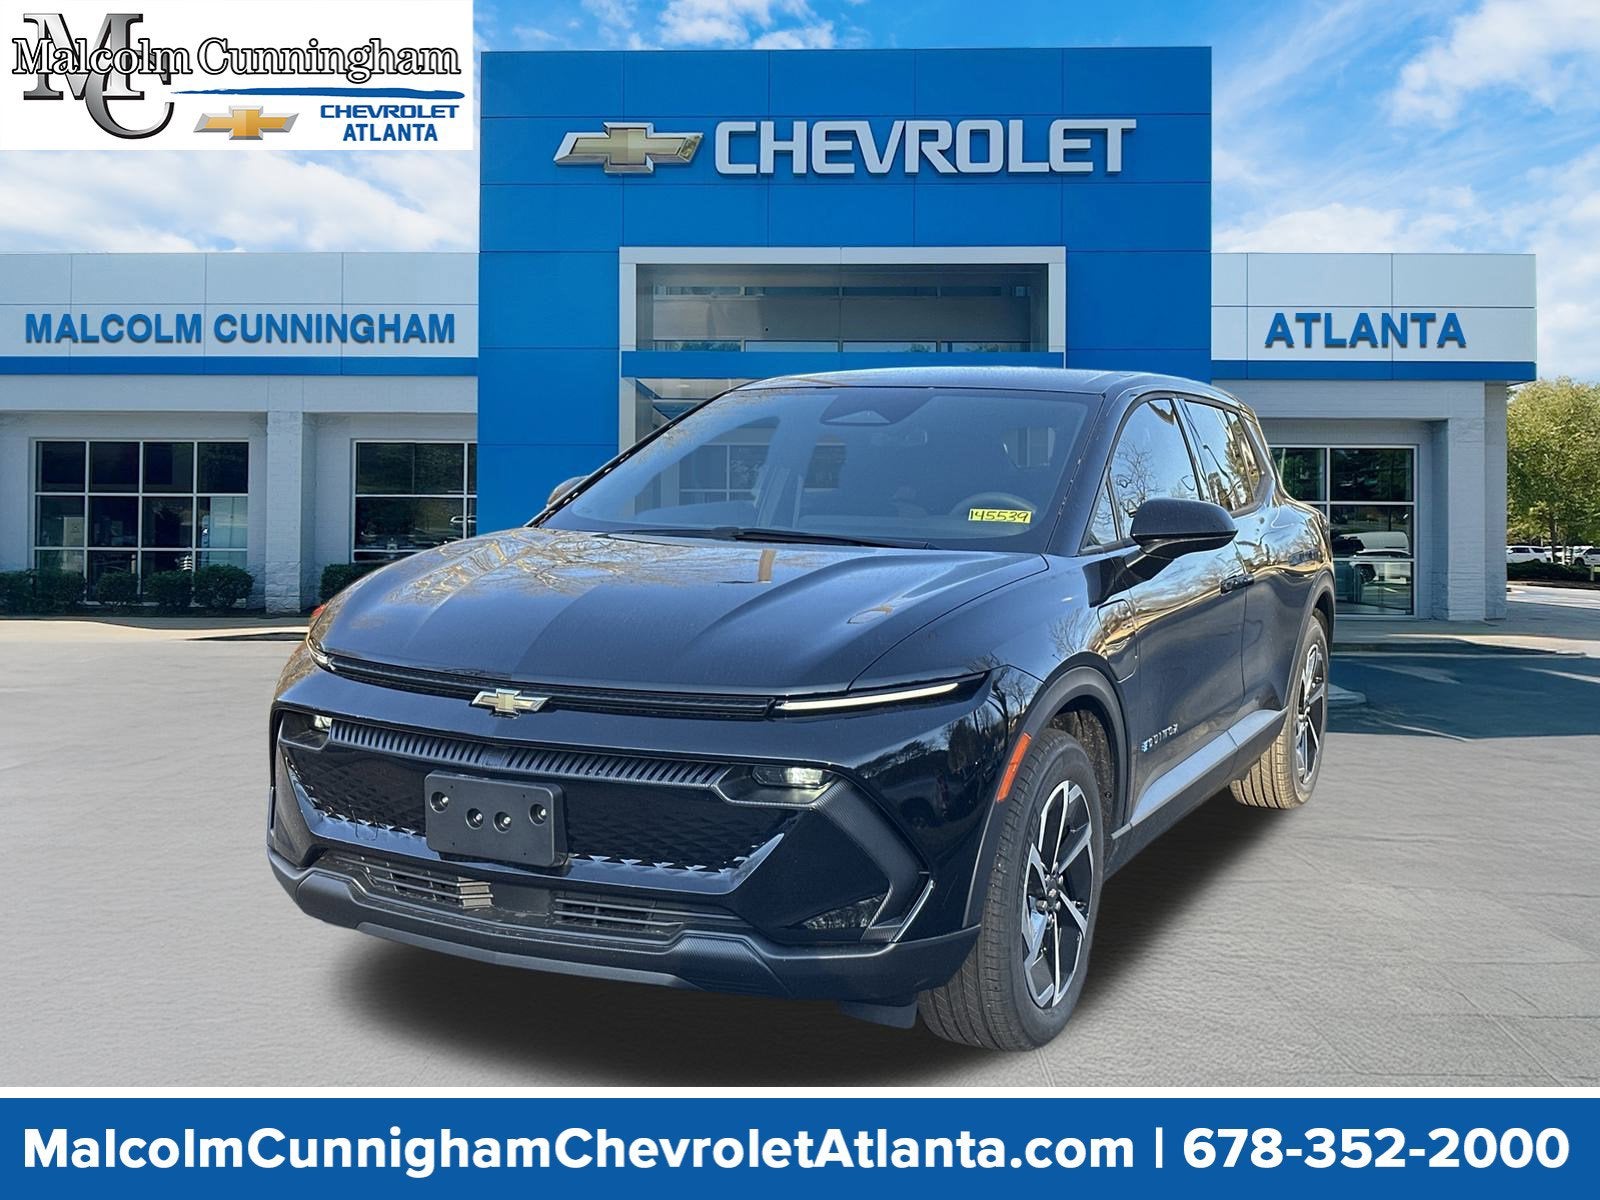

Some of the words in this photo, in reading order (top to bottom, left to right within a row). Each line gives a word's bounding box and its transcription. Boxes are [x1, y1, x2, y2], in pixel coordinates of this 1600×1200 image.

[715, 119, 1137, 175] CHEVROLET
[25, 313, 202, 343] MALCOLM
[213, 313, 456, 343] CUNNINGHAM
[1264, 312, 1467, 348] ATLANTA
[970, 509, 1029, 522] 145539
